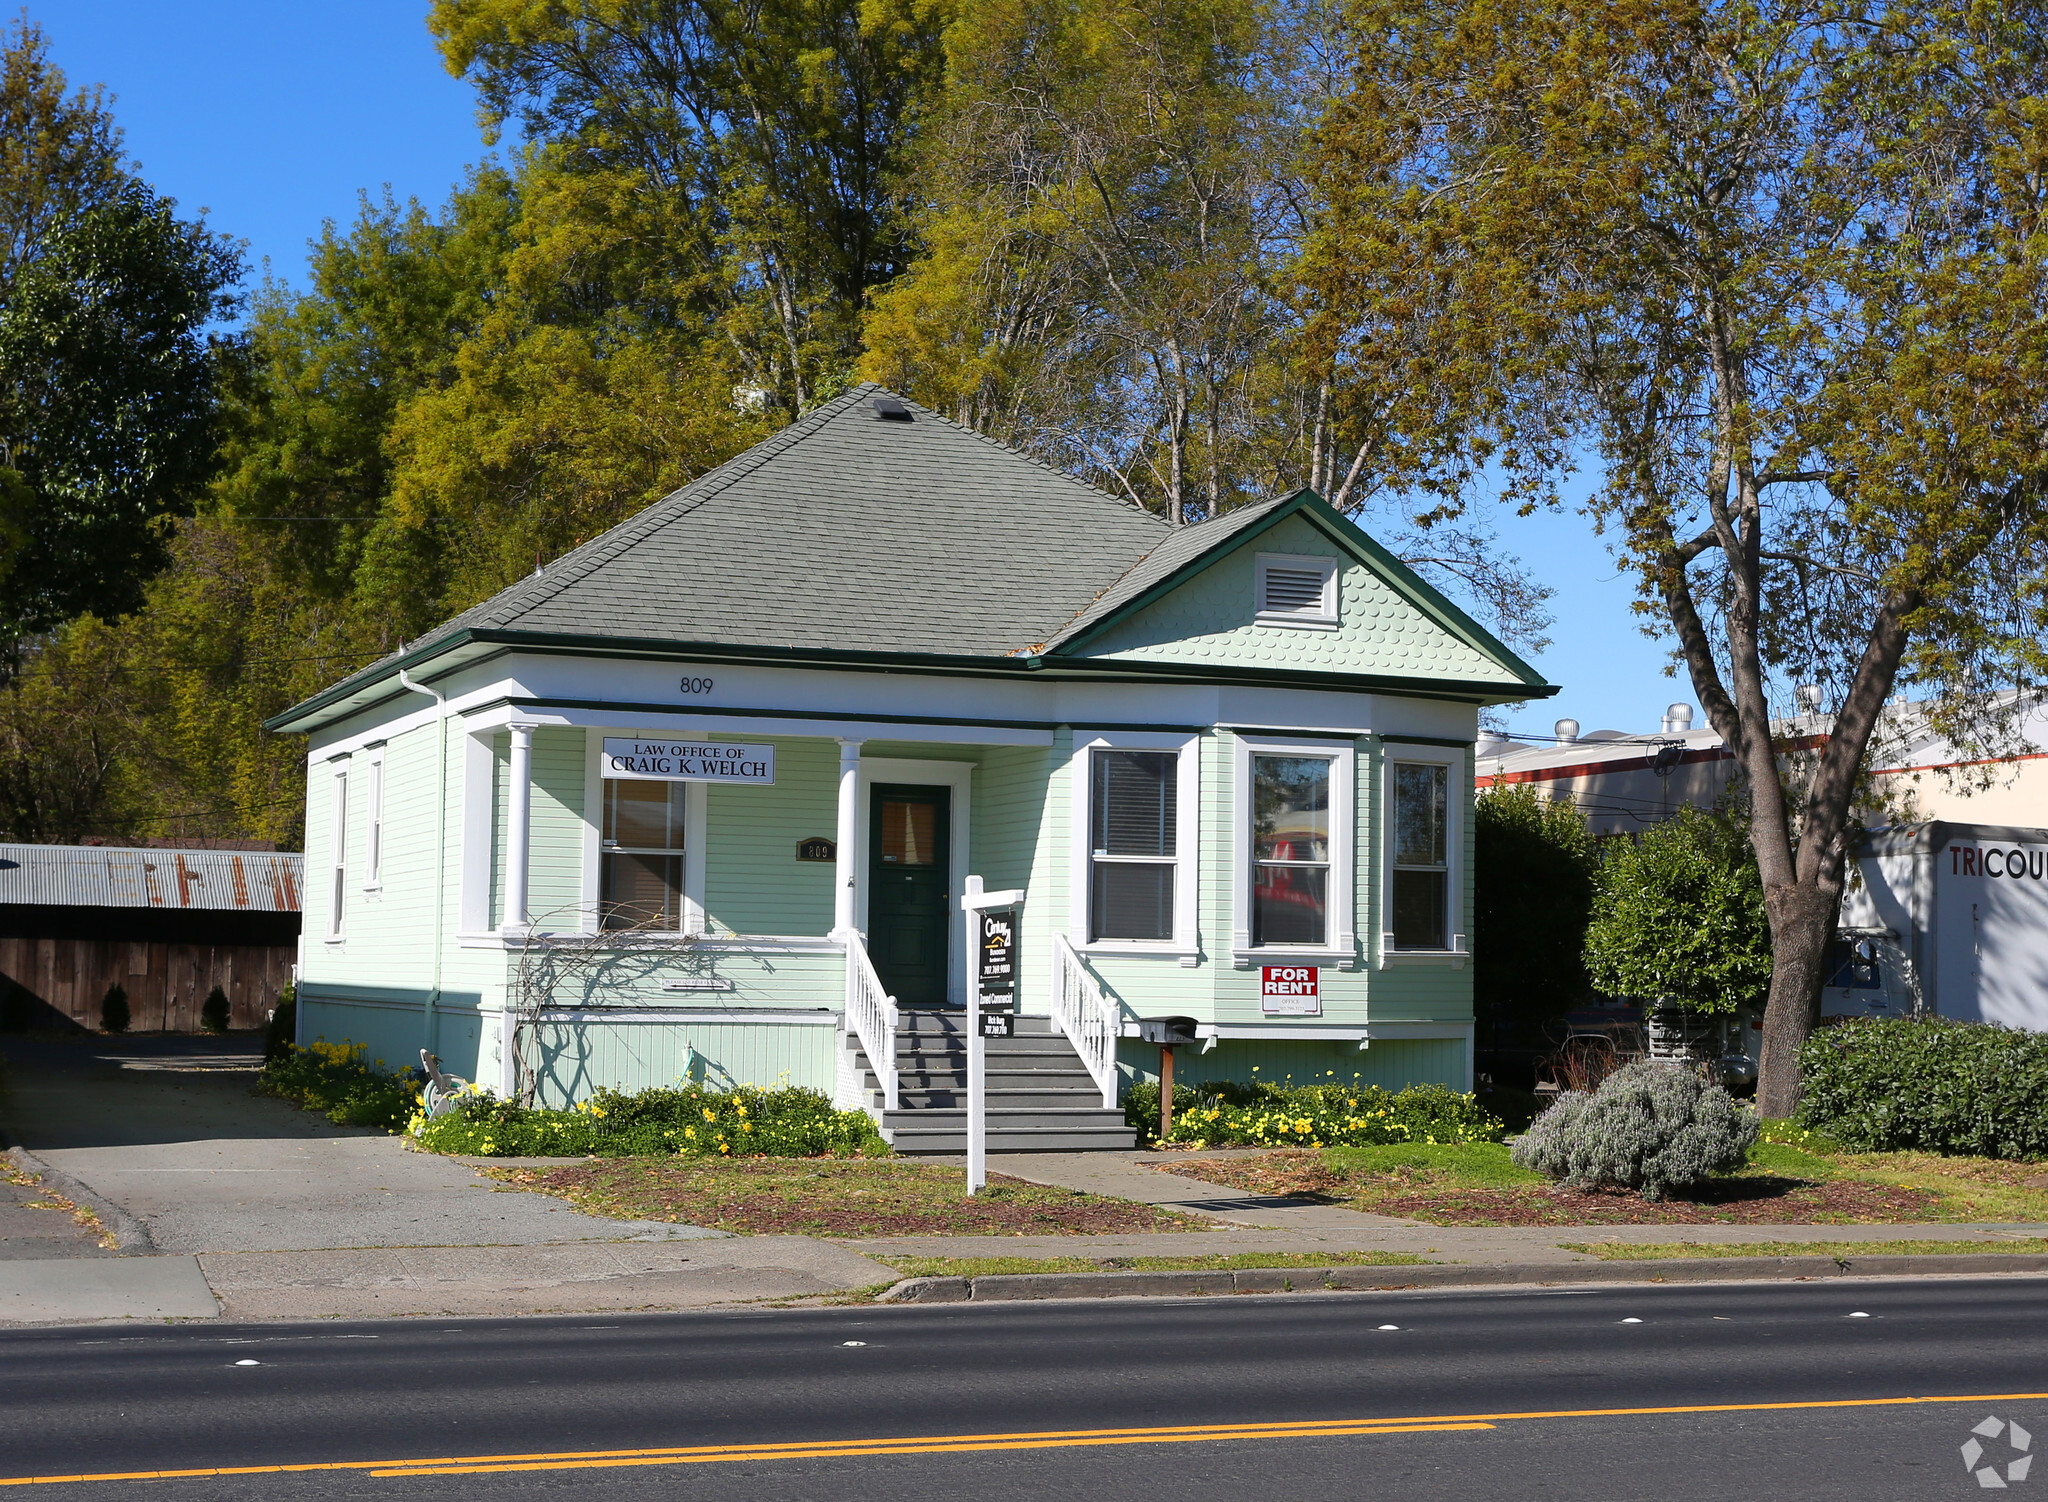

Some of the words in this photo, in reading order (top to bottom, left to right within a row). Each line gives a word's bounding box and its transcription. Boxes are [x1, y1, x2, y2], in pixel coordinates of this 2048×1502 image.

[680, 677, 714, 695] 809
[634, 744, 666, 755] LAW
[671, 745, 721, 758] OFFICE
[726, 748, 745, 759] OF
[611, 756, 671, 773] CRAIG
[679, 759, 696, 774] K.
[701, 760, 767, 777] WELCH
[808, 845, 828, 858] 809
[1949, 846, 2048, 880] TRICOU
[1270, 968, 1309, 981] FOR
[1264, 981, 1316, 994] RENT
